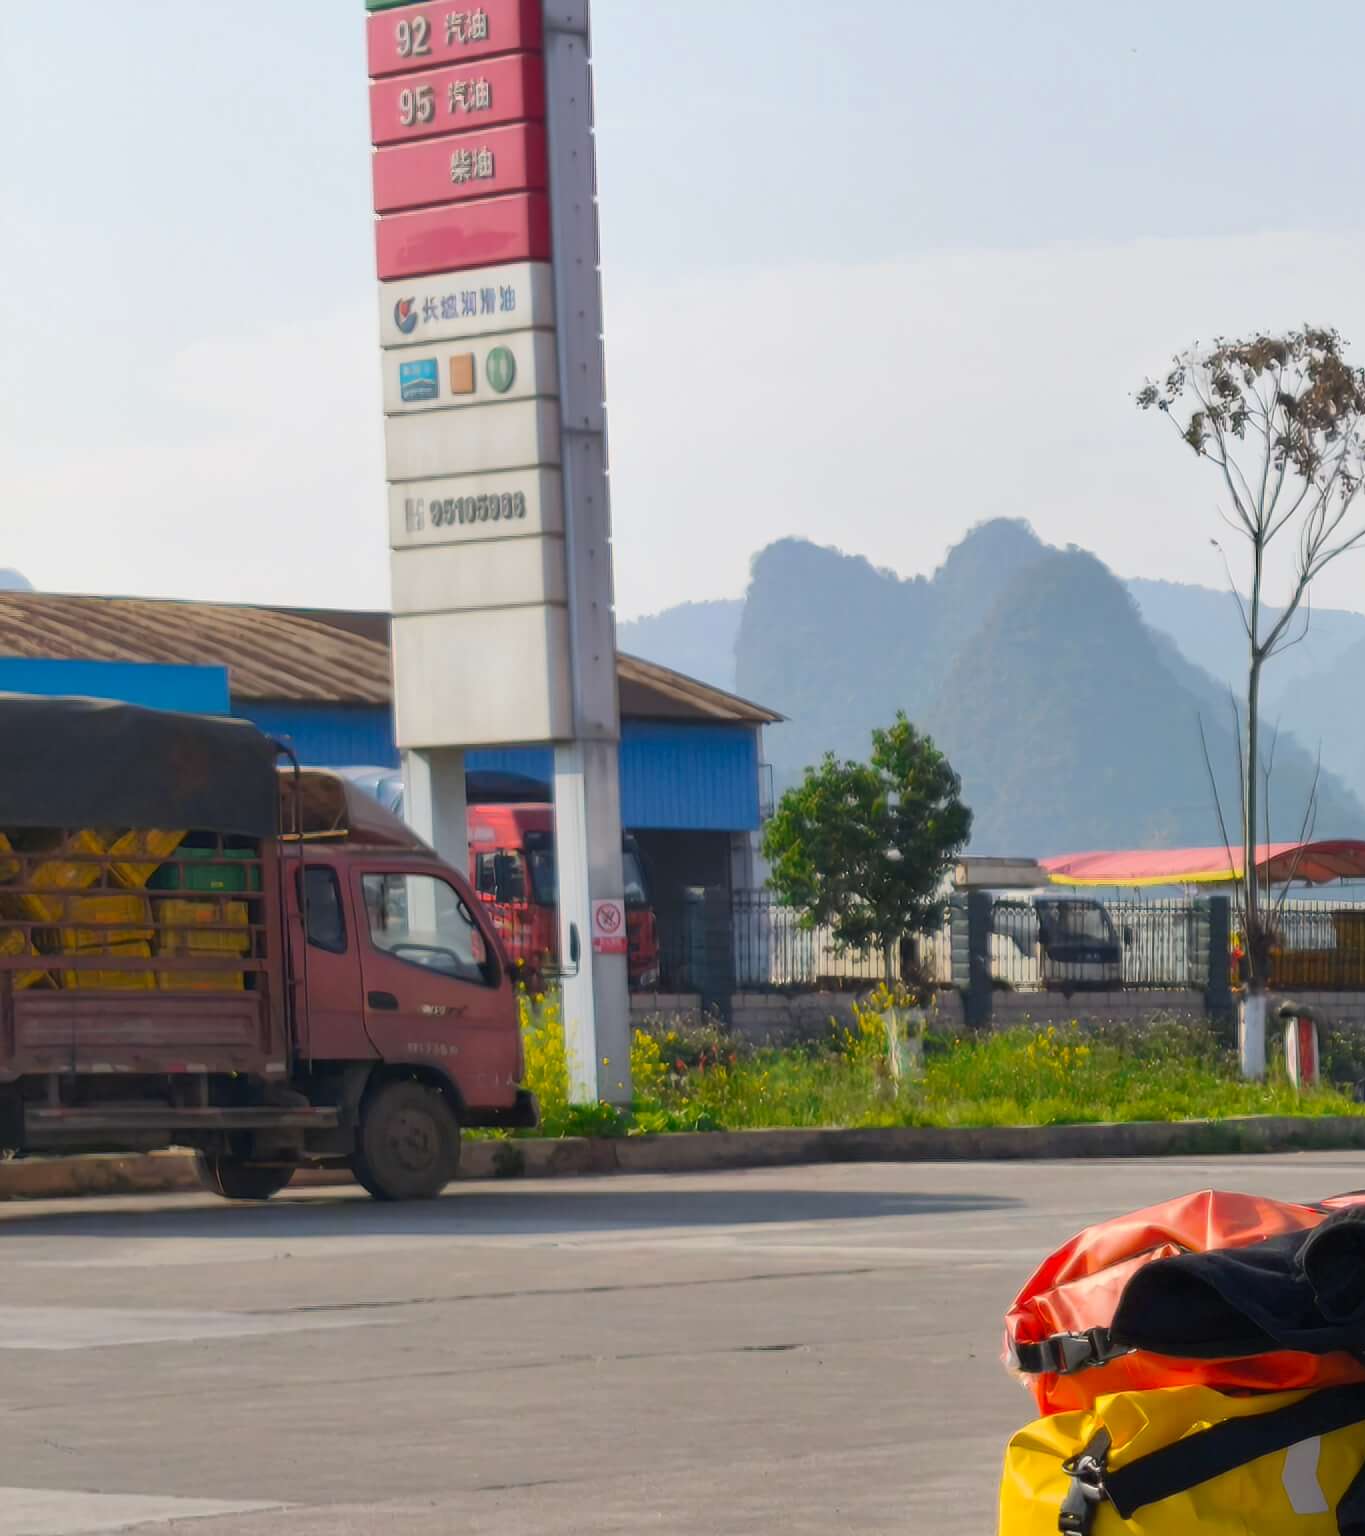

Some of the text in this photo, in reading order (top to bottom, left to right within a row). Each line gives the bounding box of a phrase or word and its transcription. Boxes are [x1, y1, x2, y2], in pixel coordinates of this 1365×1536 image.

[396, 8, 488, 56] 92 汽油
[400, 76, 491, 127] 95 汽油
[450, 145, 495, 184] 柴油
